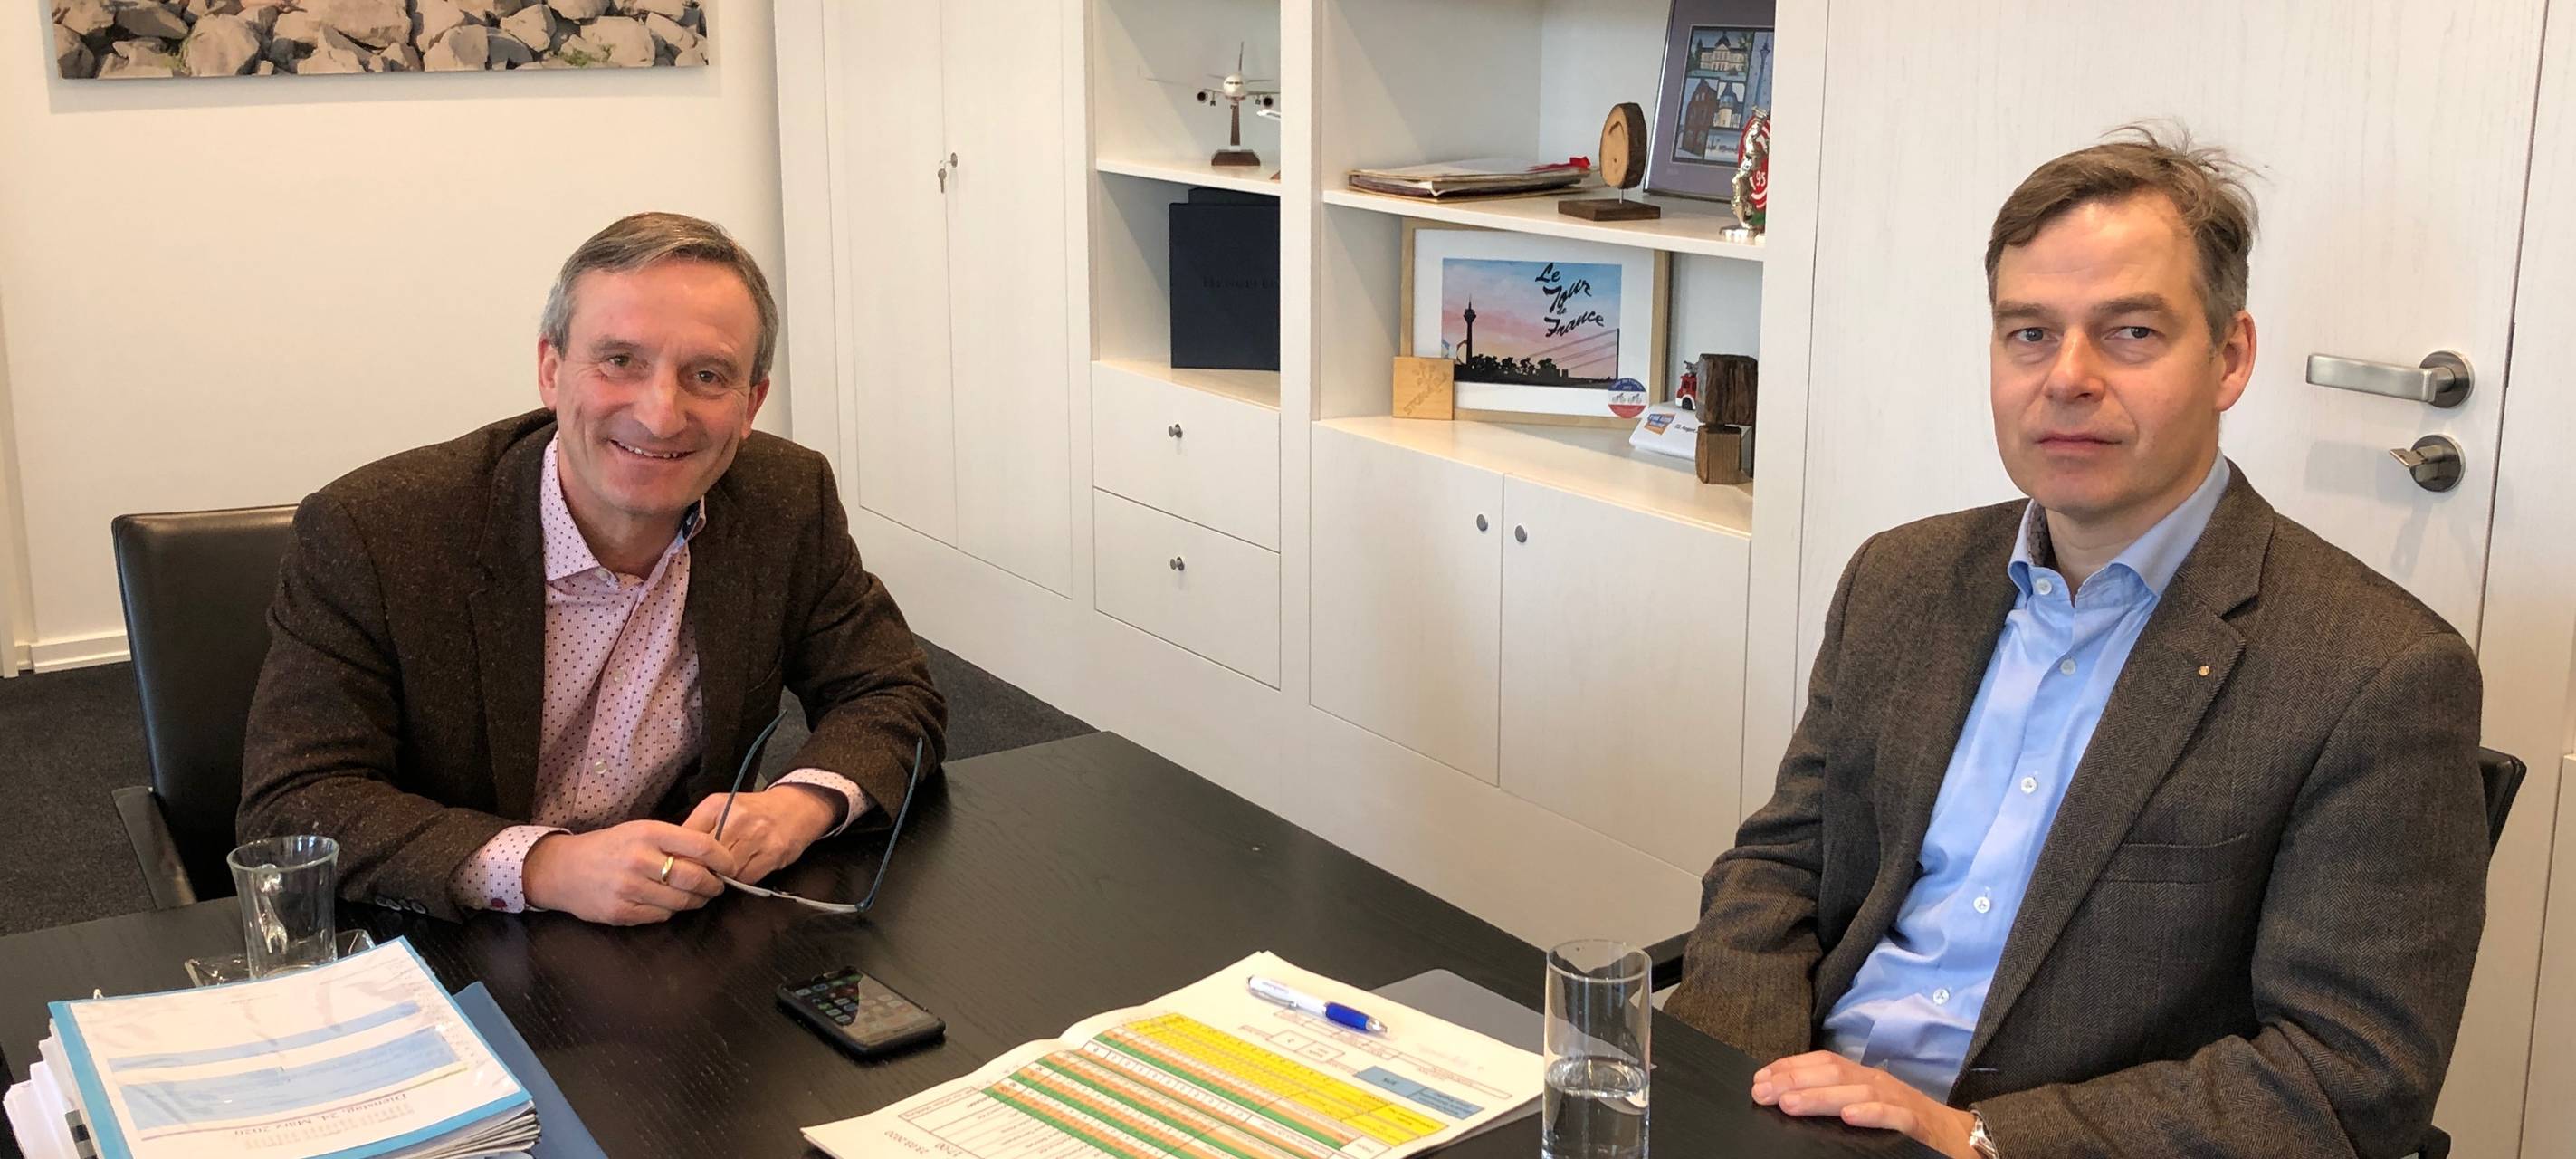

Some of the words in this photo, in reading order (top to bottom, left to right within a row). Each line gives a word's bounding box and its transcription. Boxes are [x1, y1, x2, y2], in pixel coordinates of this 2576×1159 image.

[1756, 170, 1766, 187] 95
[1535, 262, 1561, 283] Le
[1542, 279, 1592, 313] Tour
[1544, 311, 1605, 338] France
